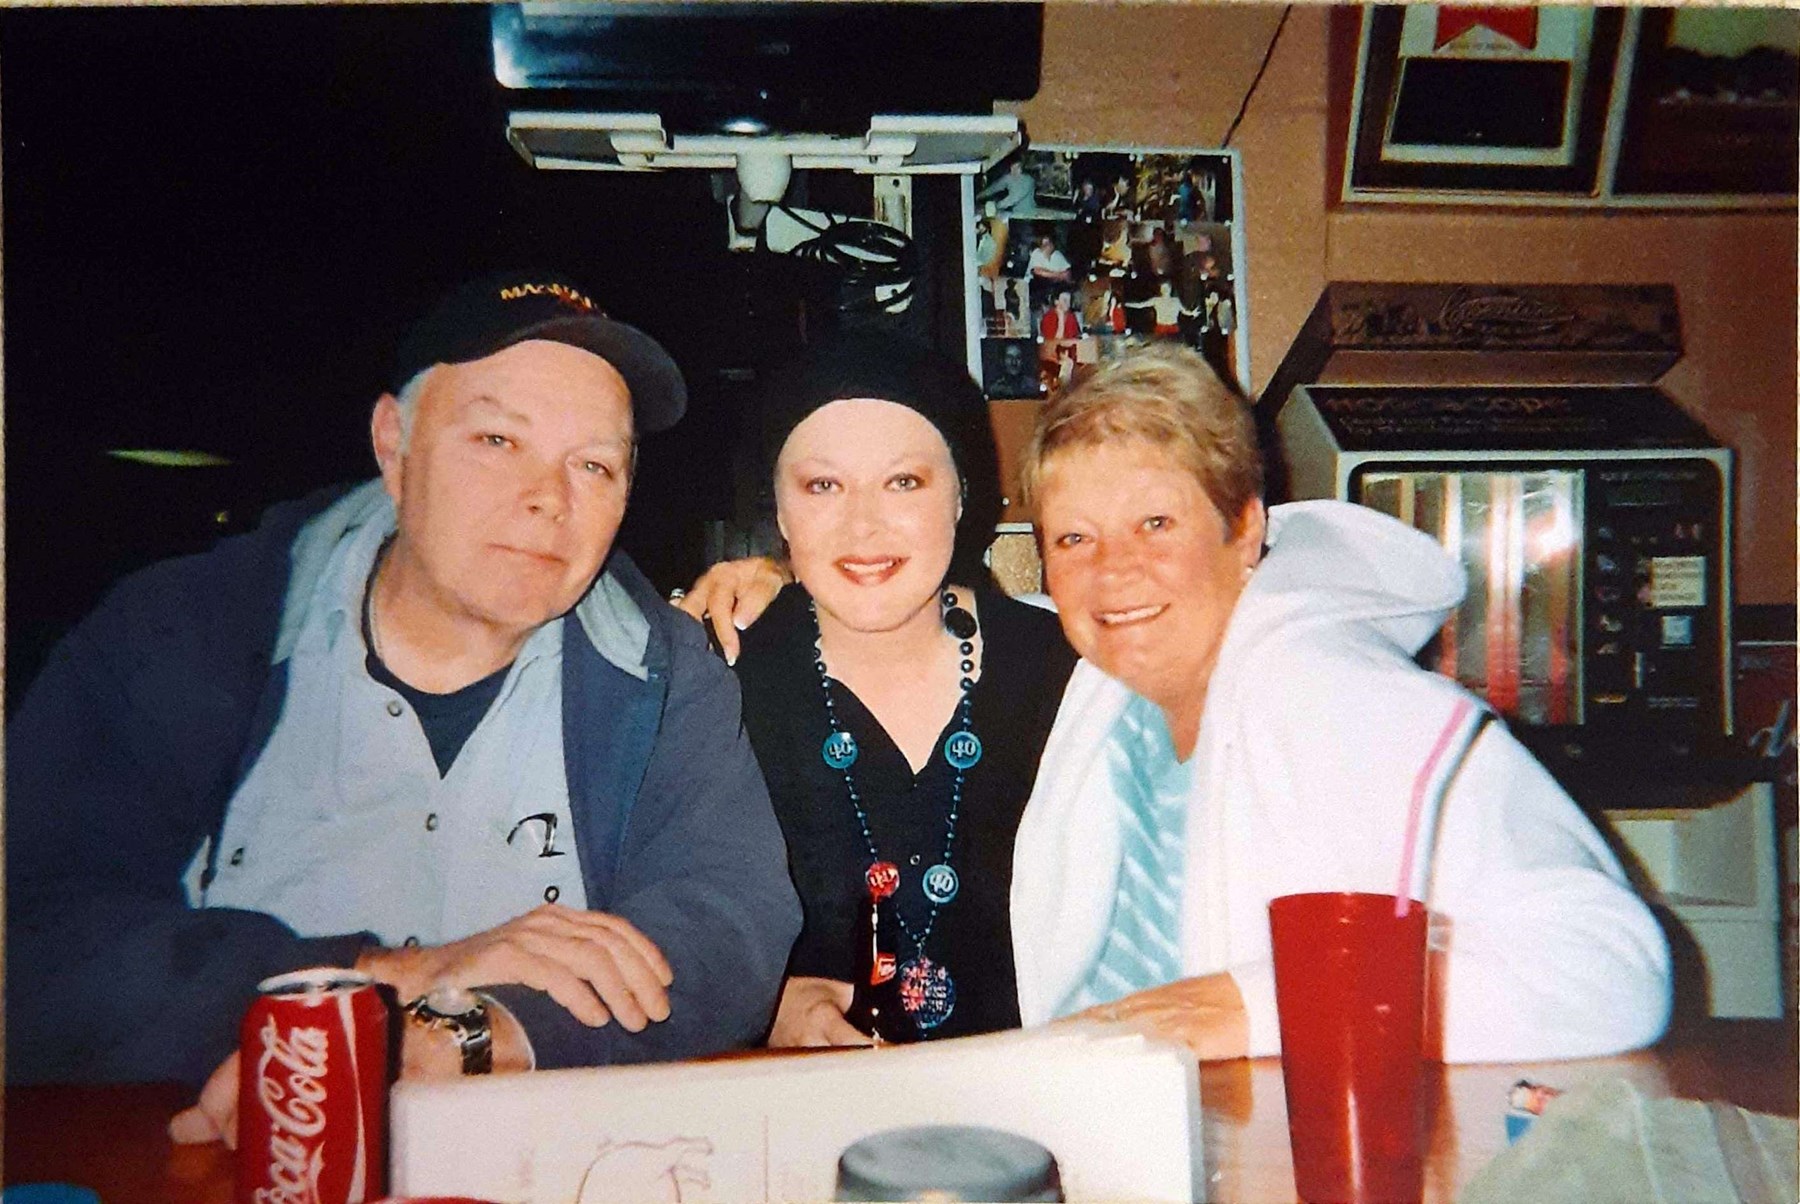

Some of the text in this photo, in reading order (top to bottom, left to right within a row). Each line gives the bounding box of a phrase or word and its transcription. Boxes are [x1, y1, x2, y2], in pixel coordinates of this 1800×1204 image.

[829, 740, 853, 759] 40
[952, 739, 977, 758] 40
[929, 872, 955, 892] 40
